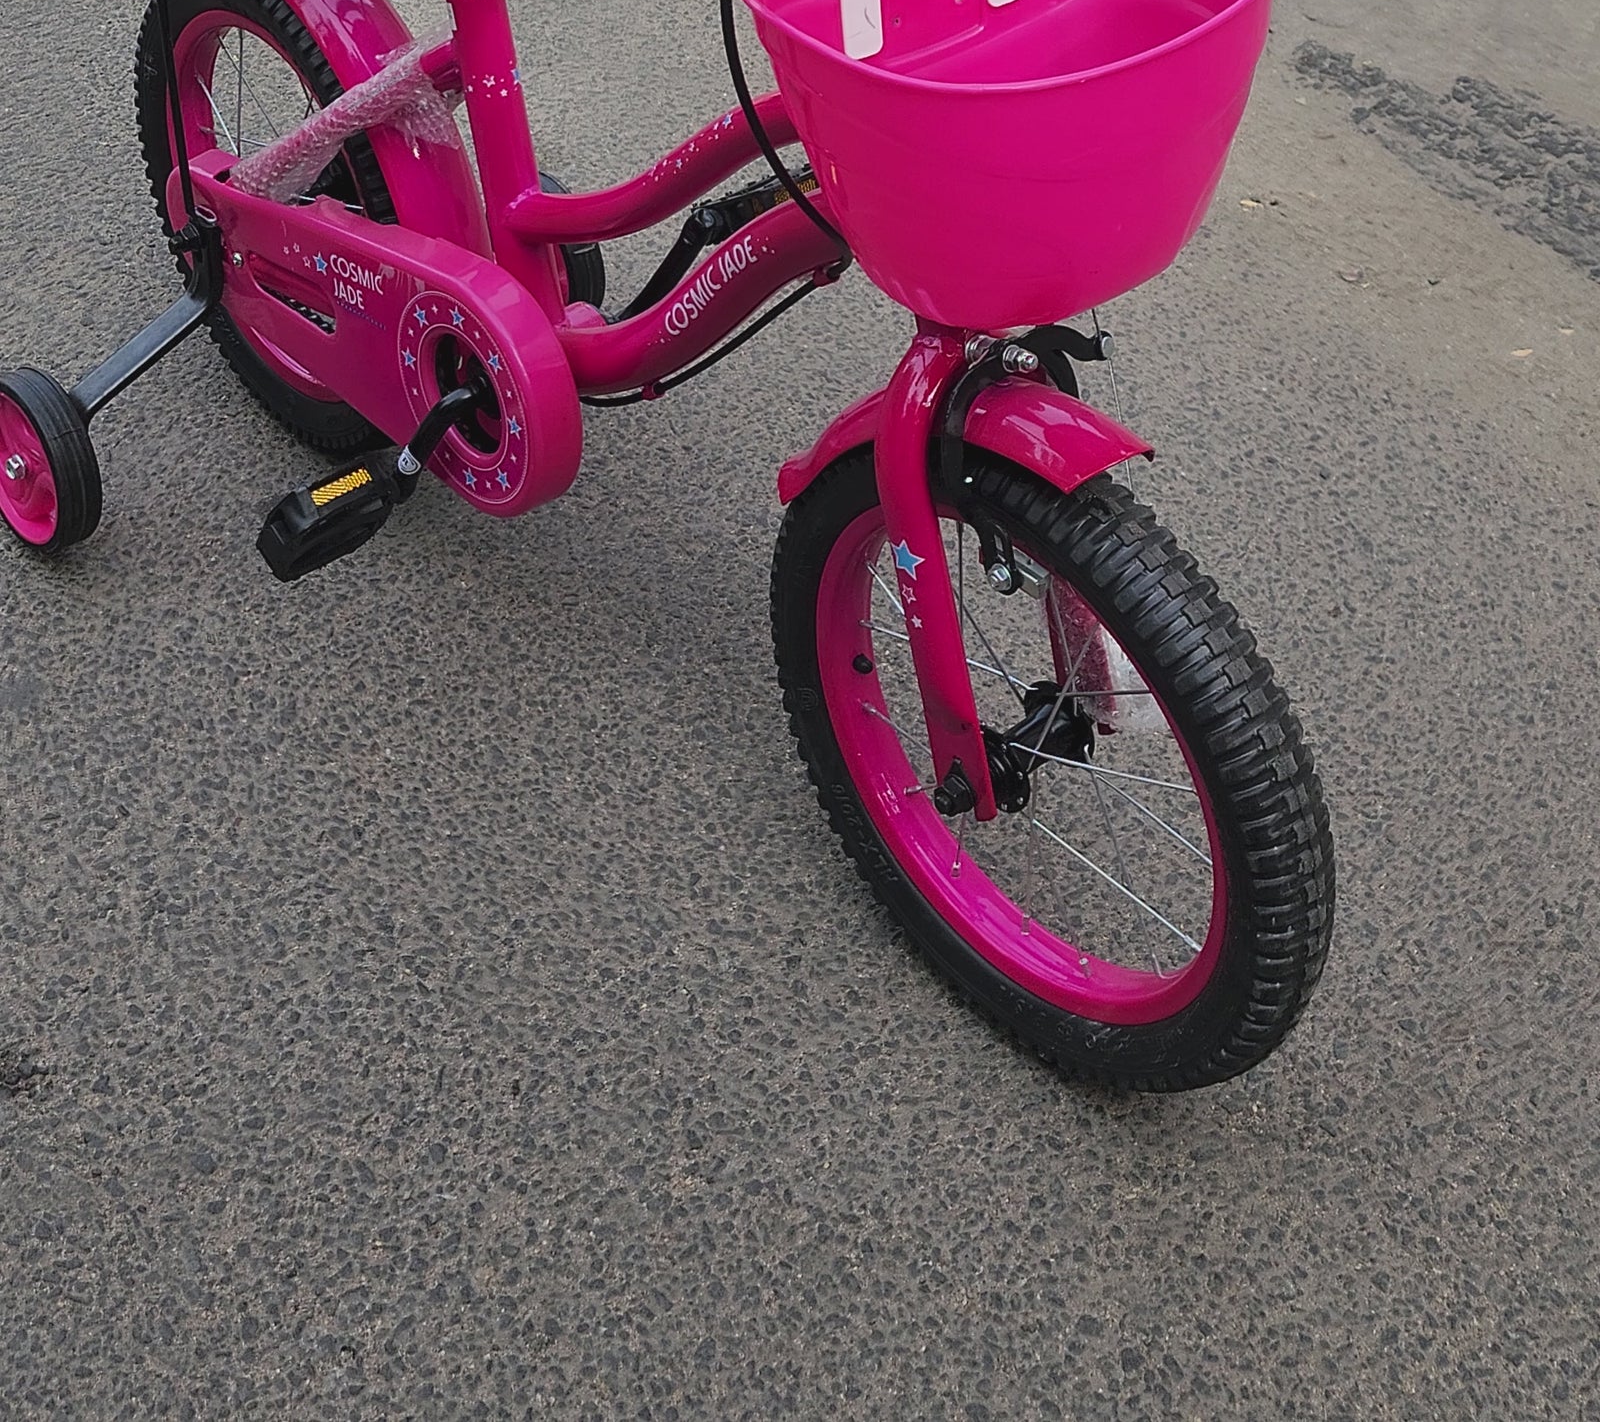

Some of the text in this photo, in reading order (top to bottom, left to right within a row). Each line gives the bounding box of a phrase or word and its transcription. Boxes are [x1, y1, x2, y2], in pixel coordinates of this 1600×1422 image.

[330, 254, 384, 295] COSMIC
[333, 278, 365, 310] JADE
[665, 235, 758, 335] COSMIC JADE
